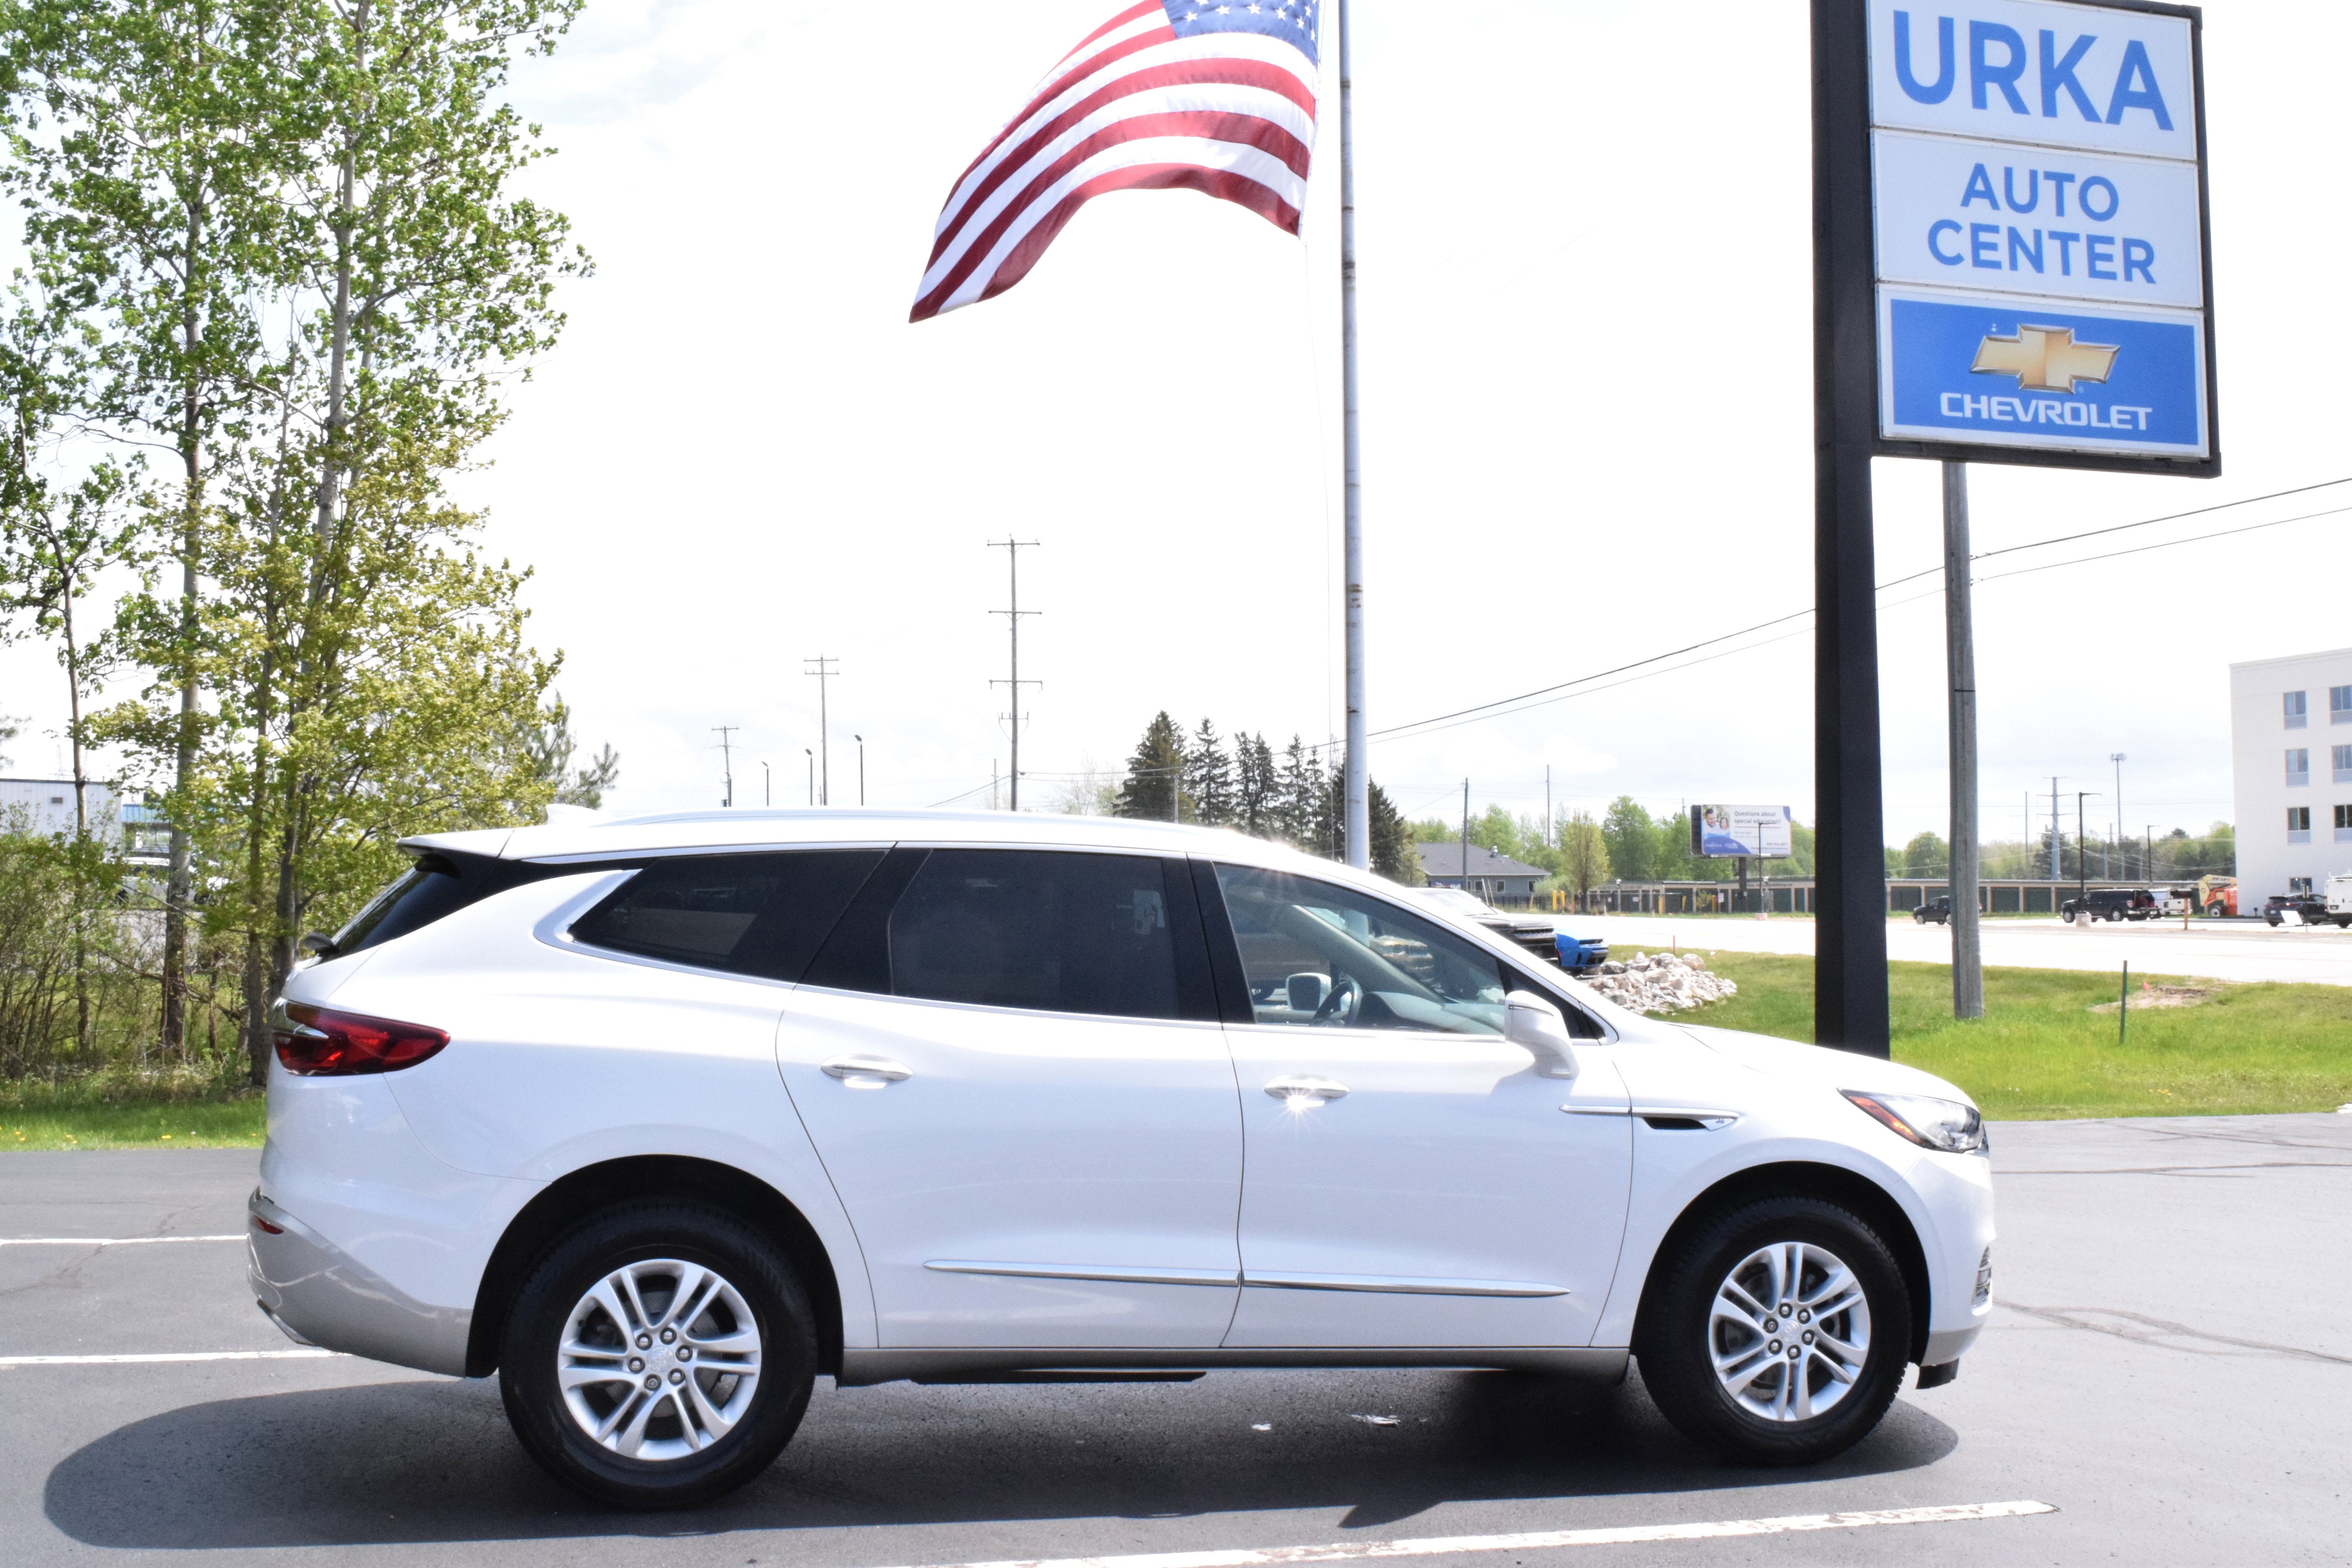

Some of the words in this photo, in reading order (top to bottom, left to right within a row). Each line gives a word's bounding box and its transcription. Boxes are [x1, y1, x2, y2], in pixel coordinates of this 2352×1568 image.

[1893, 10, 2174, 131] URKA
[1960, 163, 2120, 222] AUTO
[1928, 219, 2156, 284] CENTER
[1940, 392, 2152, 430] CHEVROLET
